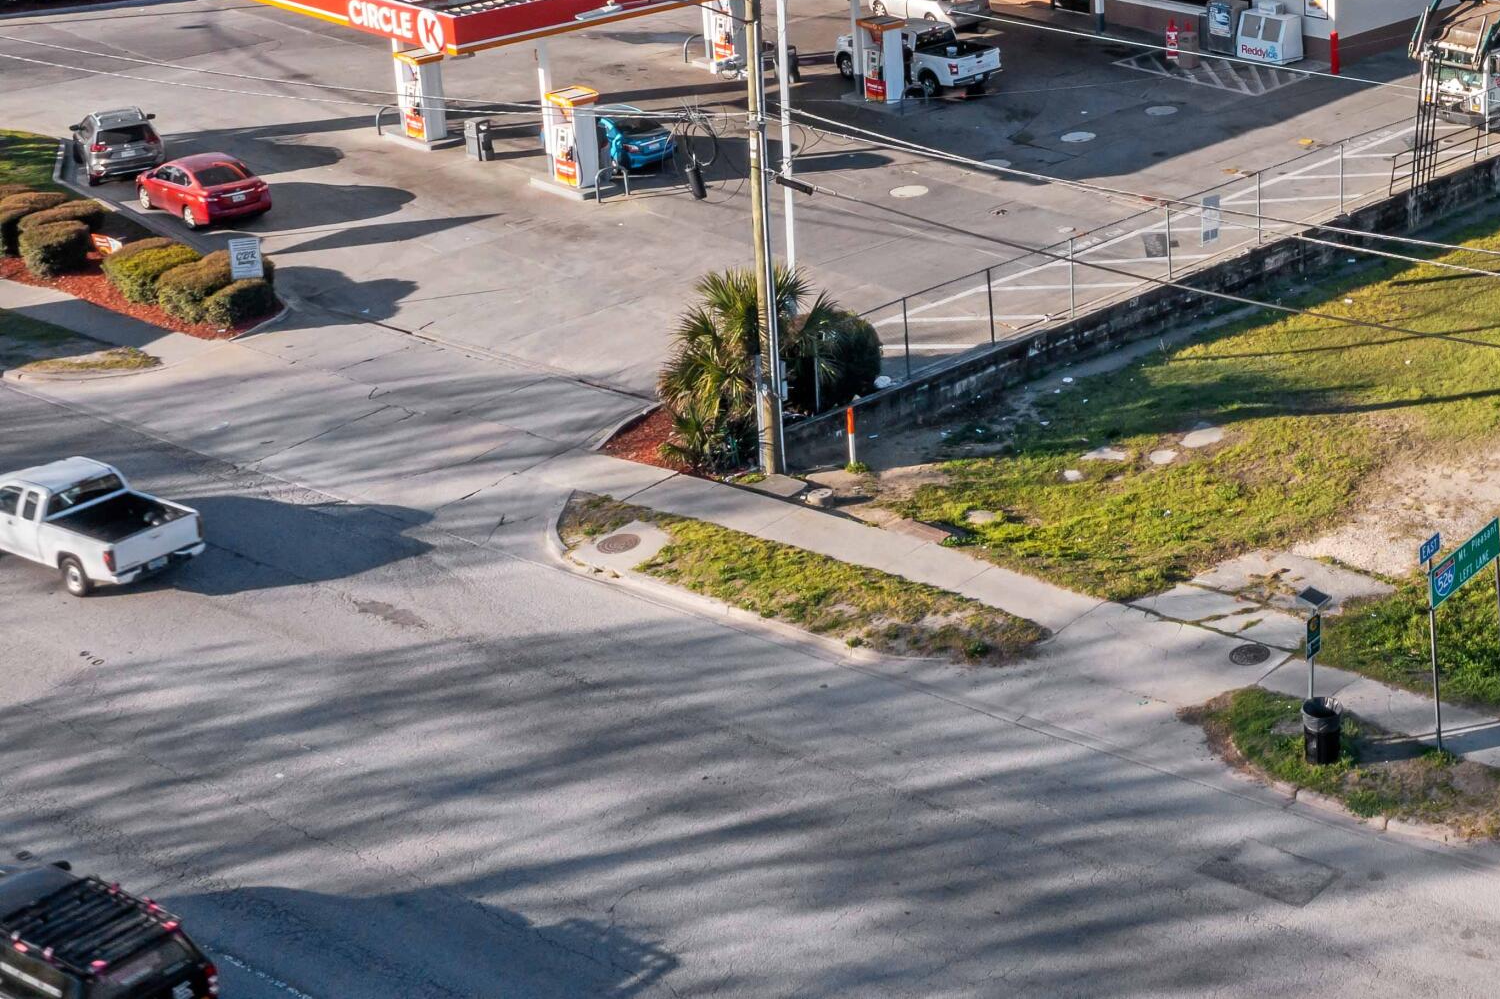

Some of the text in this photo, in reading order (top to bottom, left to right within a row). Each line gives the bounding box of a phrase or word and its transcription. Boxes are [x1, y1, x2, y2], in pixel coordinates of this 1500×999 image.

[348, 0, 442, 50] CIRCLE K
[1422, 539, 1438, 559] EAST
[1471, 522, 1497, 551] Pleasant
[1460, 563, 1473, 582] LEFT
[1475, 549, 1489, 569] LANE
[1438, 570, 1453, 593] 526
